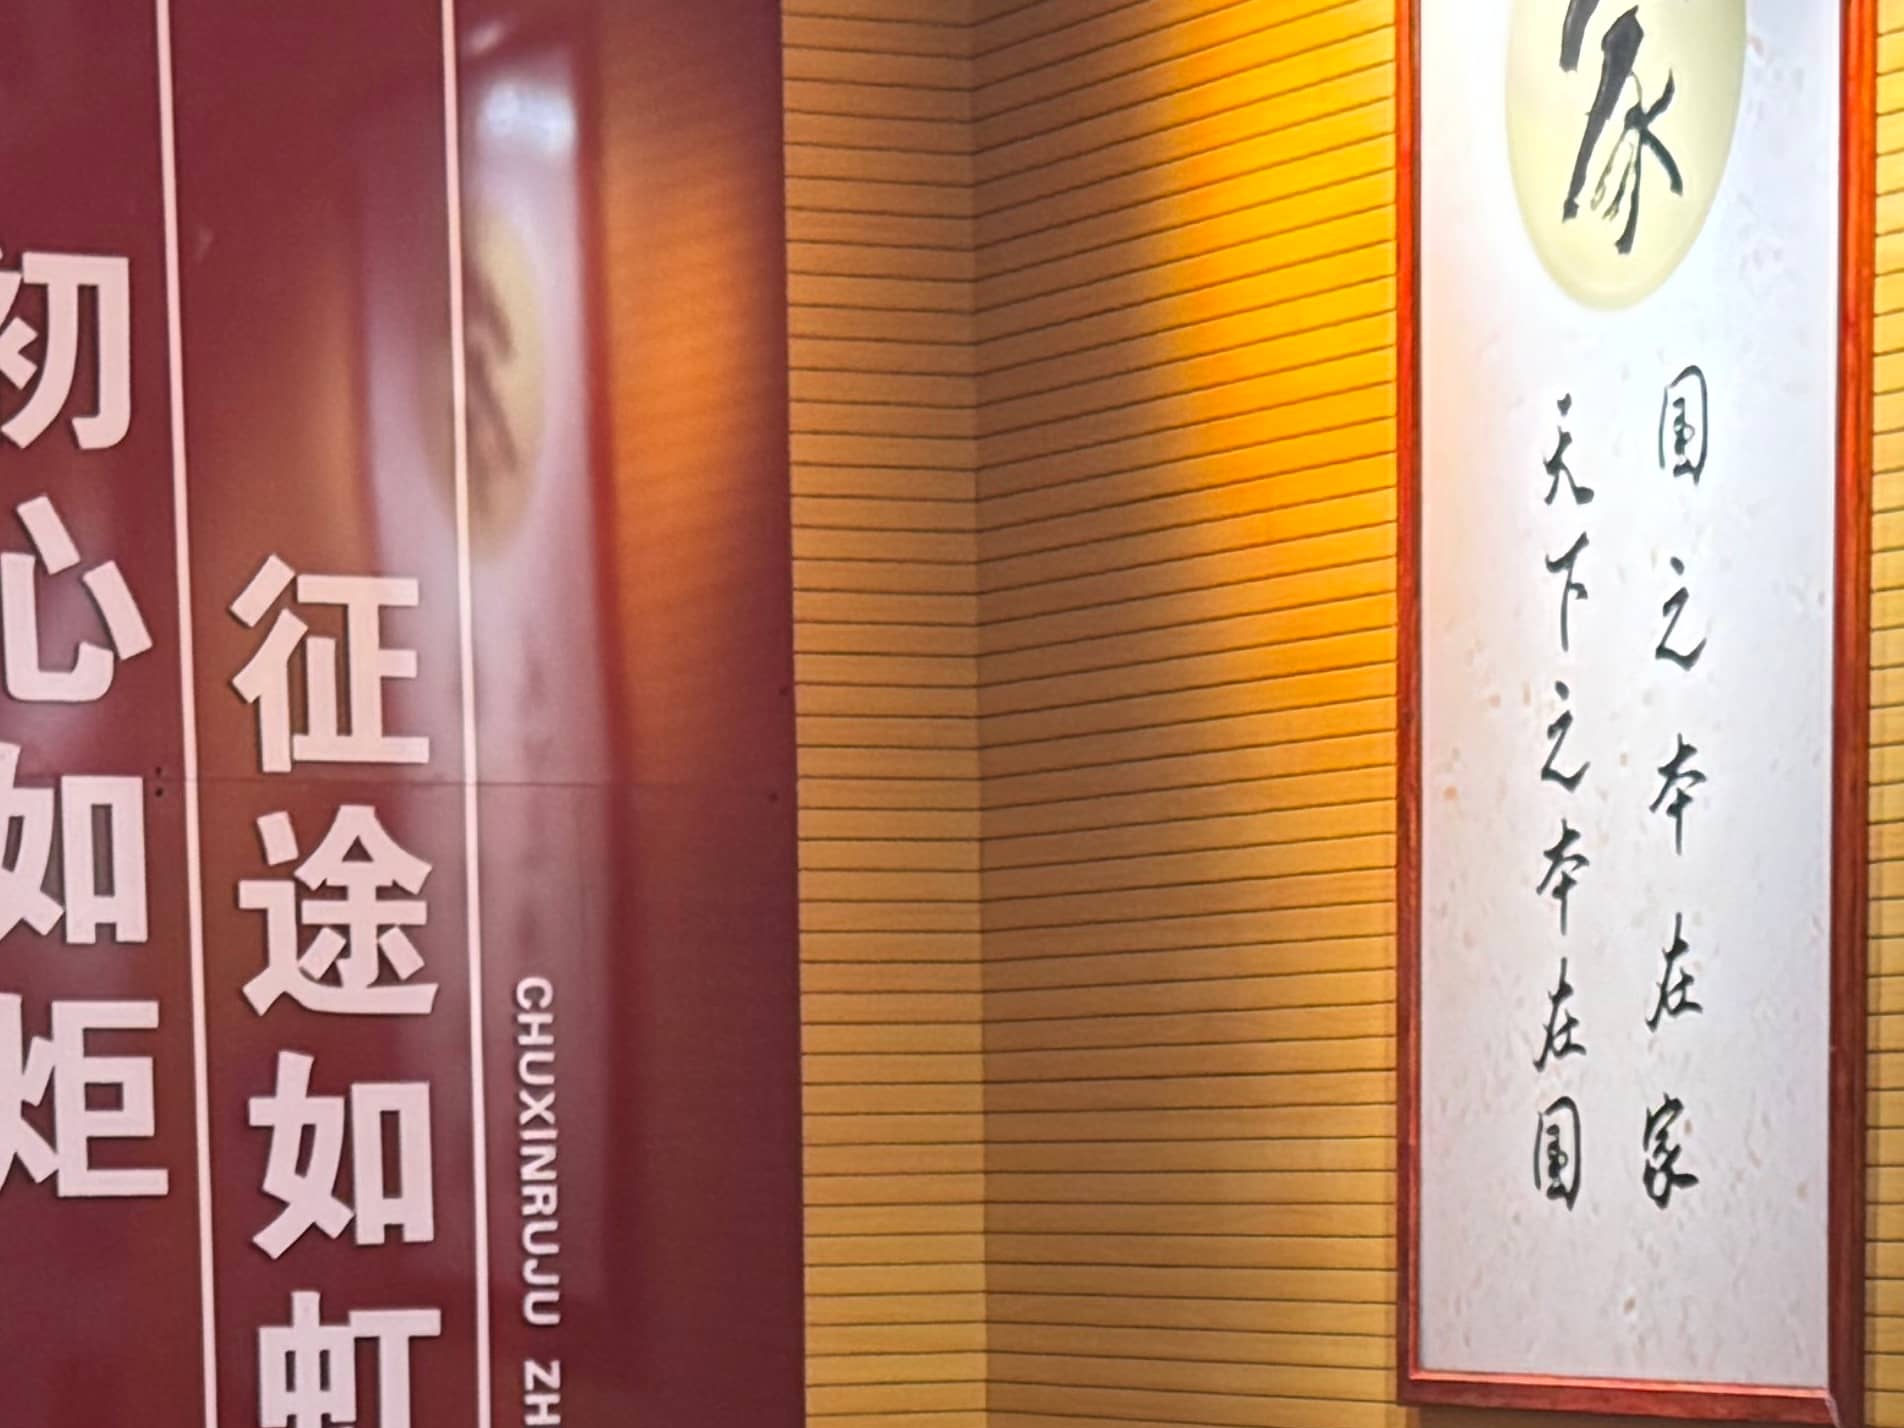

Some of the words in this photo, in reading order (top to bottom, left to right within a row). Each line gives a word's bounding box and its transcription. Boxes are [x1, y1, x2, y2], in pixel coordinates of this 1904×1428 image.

[515, 975, 562, 1327] CHUXINRUJU
[1532, 393, 1595, 1210] 天下之本在国
[1643, 364, 1709, 1209] 国之本在家
